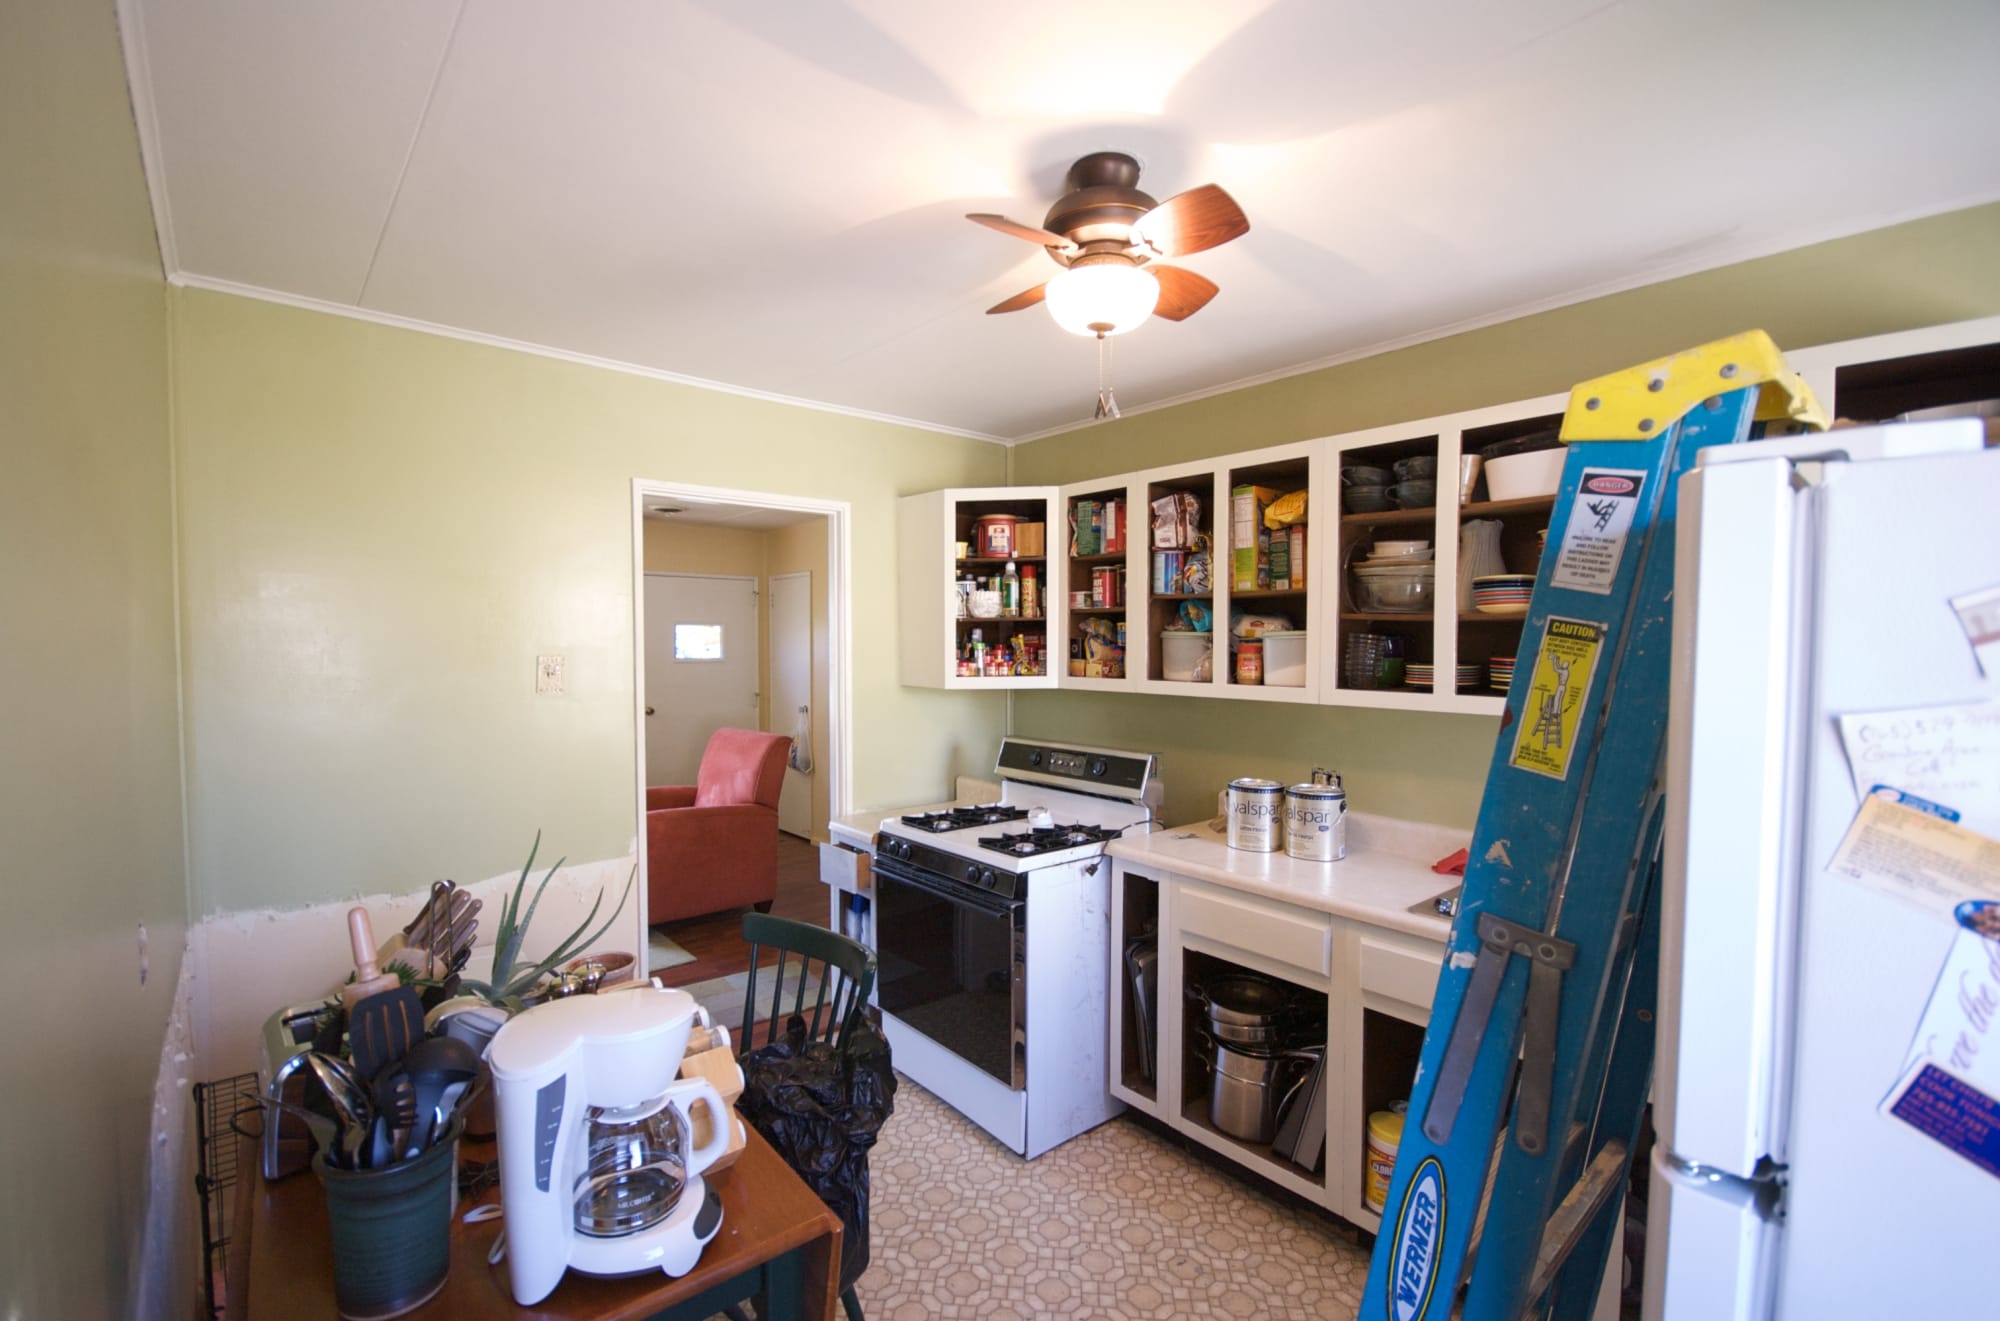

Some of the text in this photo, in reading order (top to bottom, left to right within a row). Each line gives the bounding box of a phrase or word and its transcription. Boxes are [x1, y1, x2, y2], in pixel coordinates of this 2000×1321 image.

[1551, 622, 1596, 638] CAUTION
[1233, 800, 1281, 820] valspar
[1397, 1191, 1436, 1309] WERNER
